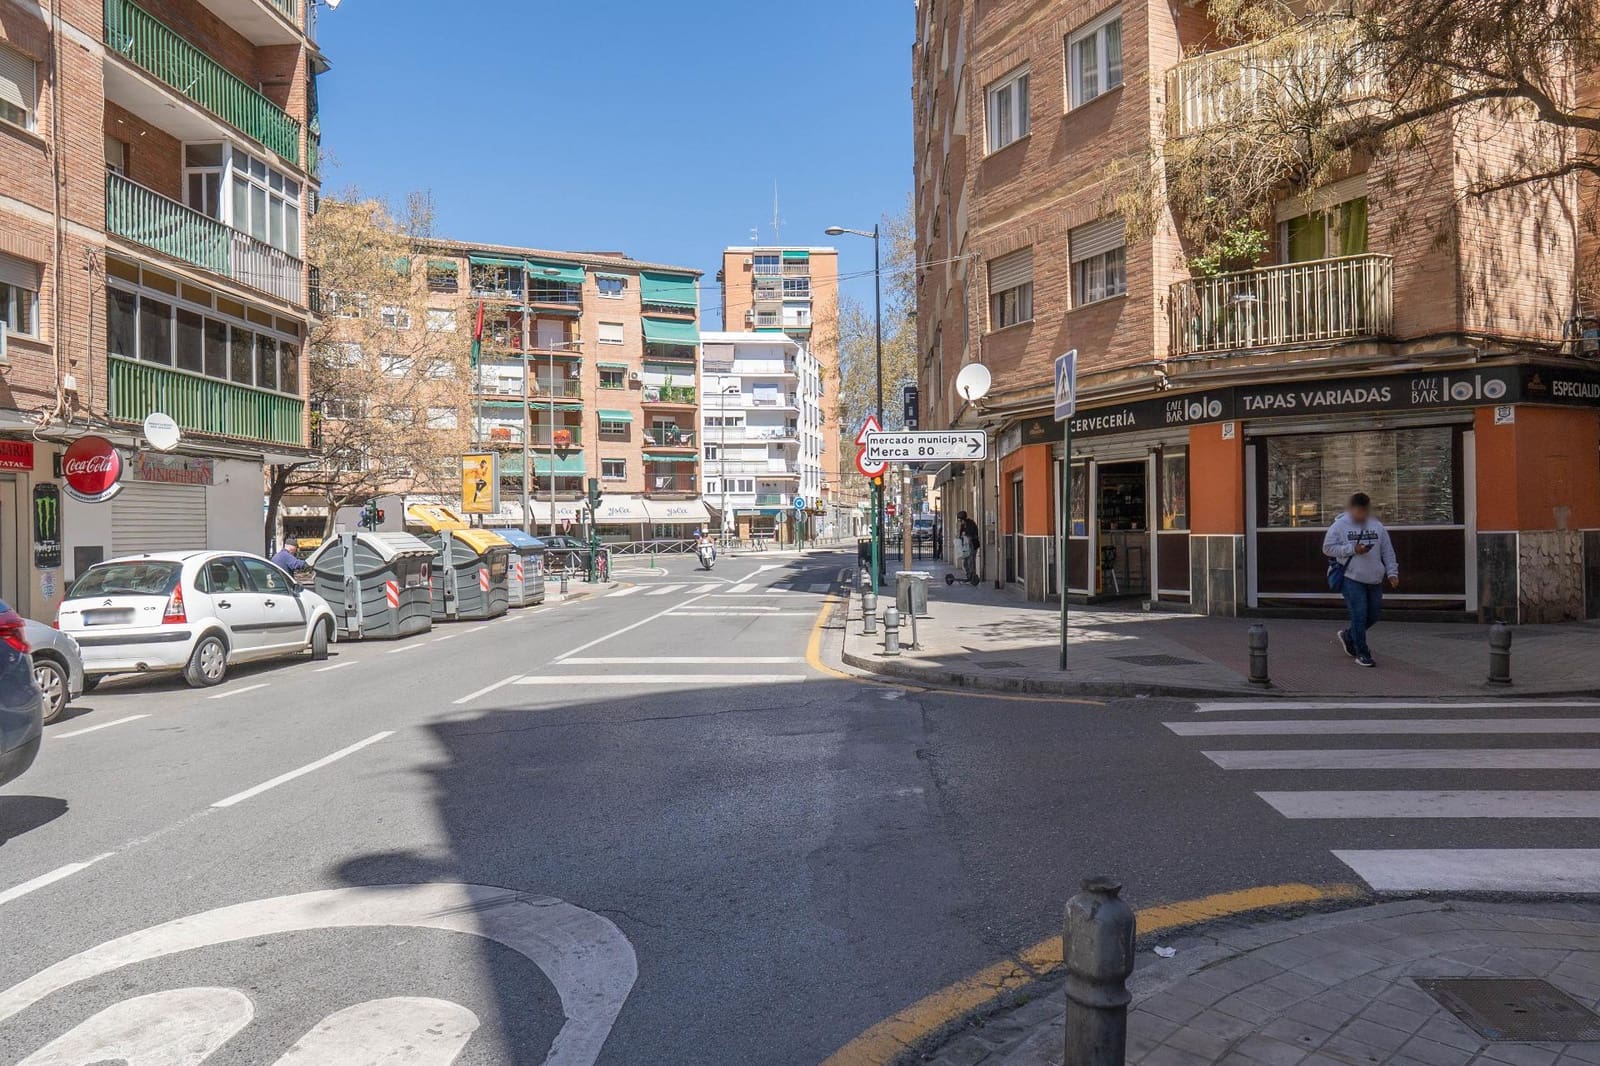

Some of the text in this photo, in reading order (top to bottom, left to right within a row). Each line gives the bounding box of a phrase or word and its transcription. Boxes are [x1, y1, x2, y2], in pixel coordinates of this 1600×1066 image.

[1411, 390, 1441, 404] BAR
[1443, 374, 1507, 401] lolo
[1184, 396, 1223, 421] lolo
[1243, 386, 1392, 411] TAPAS VARIADAS
[1070, 409, 1136, 433] CERVECERÍA
[1166, 410, 1184, 423] BAR
[870, 435, 968, 447] mercado municipal
[870, 446, 935, 457] Merca 80
[66, 454, 113, 475] Coca-Cola
